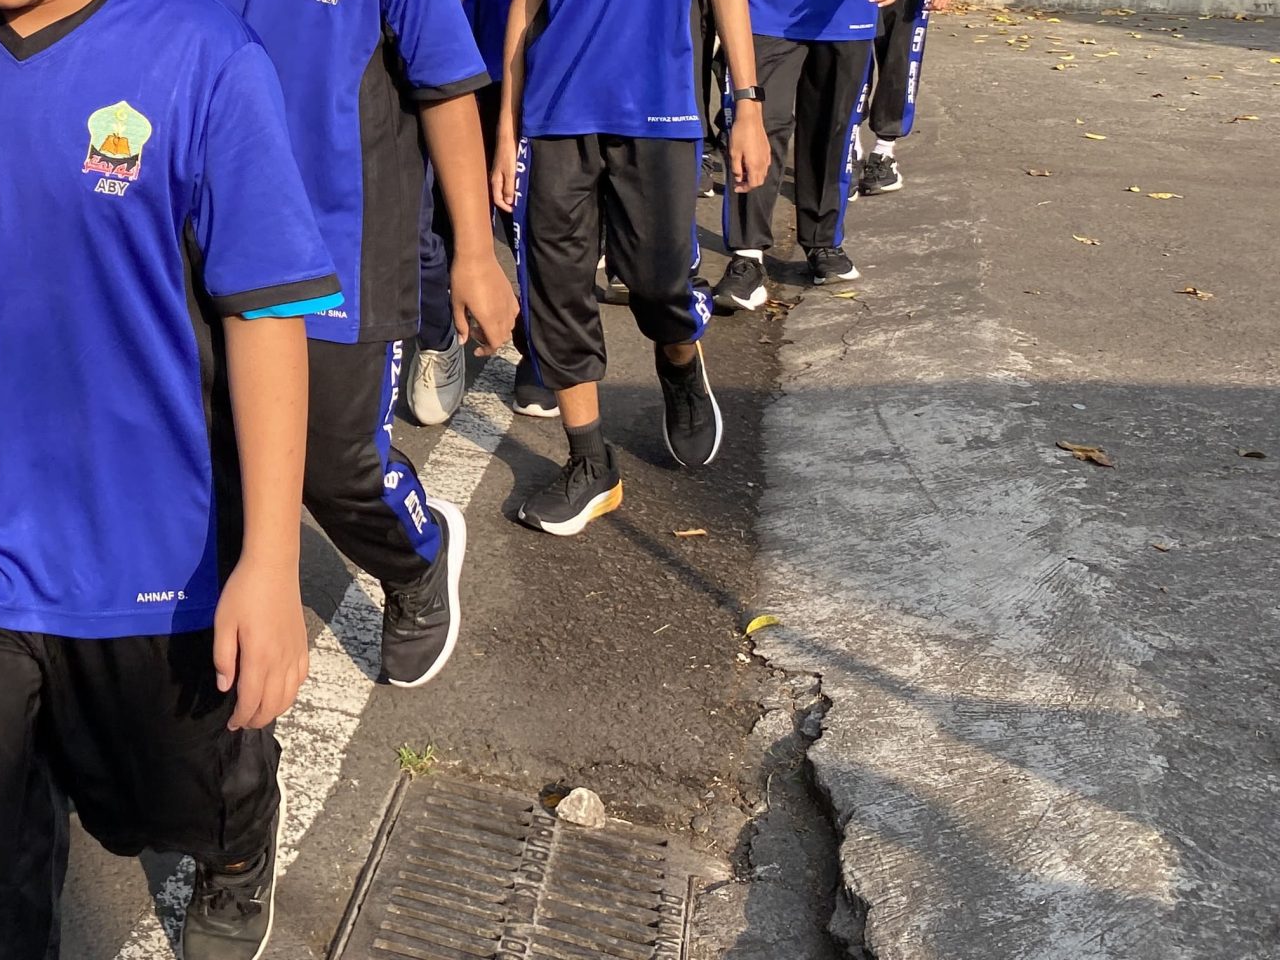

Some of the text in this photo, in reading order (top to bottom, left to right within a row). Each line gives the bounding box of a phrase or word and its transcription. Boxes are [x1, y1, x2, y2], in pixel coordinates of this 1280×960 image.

[94, 178, 130, 196] ABY
[328, 309, 347, 319] SINA
[136, 590, 189, 602] AHNAF S.
